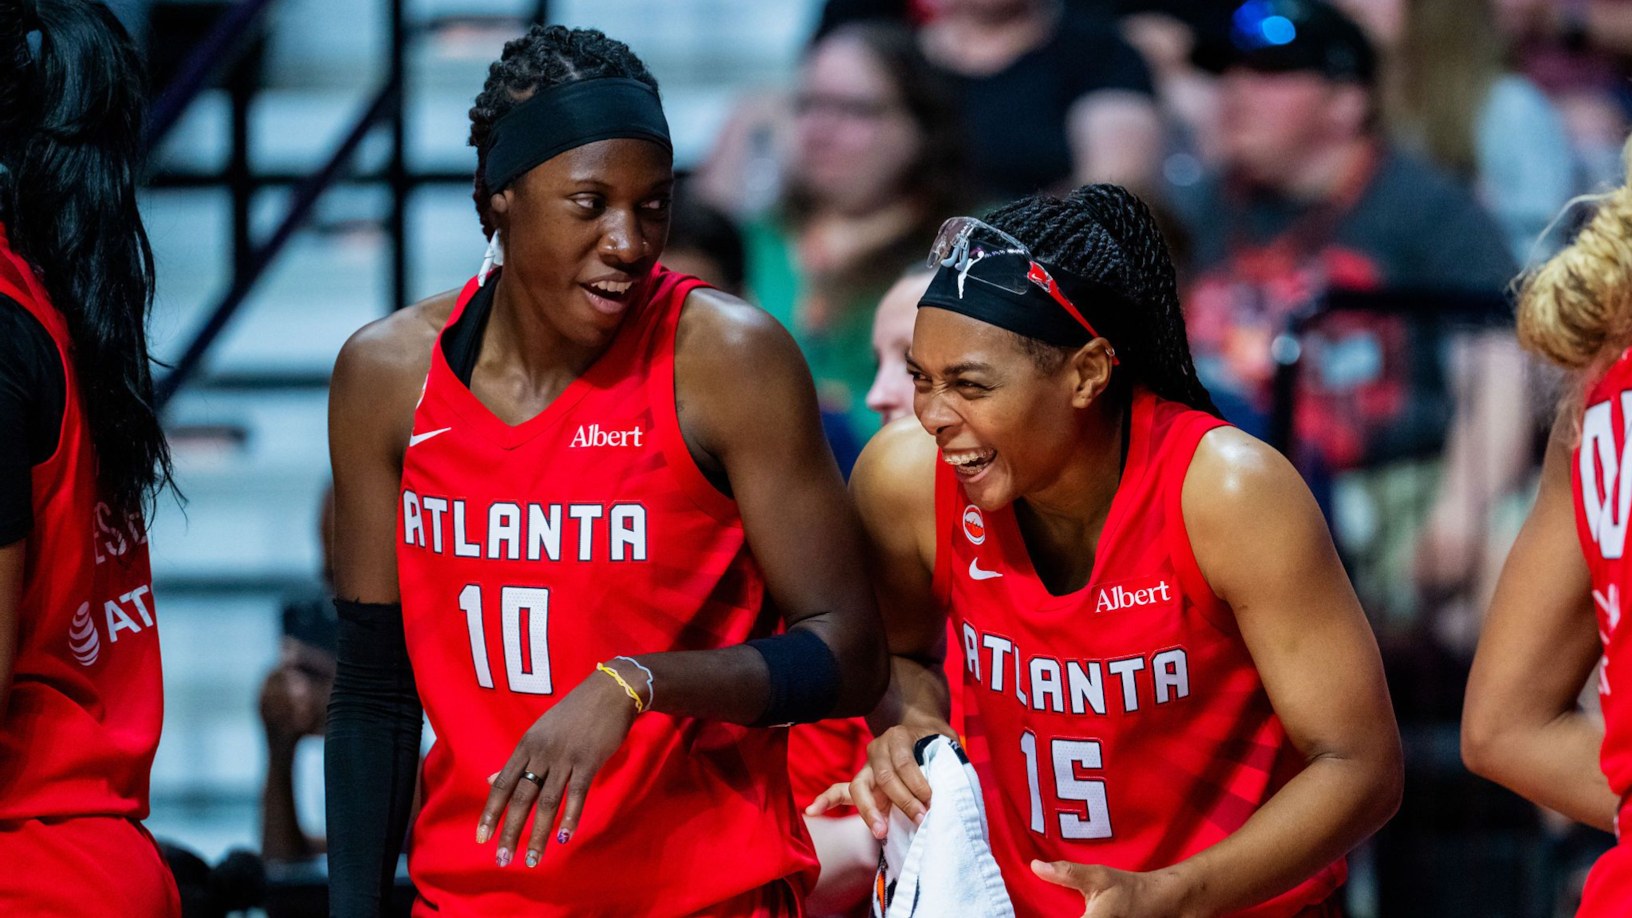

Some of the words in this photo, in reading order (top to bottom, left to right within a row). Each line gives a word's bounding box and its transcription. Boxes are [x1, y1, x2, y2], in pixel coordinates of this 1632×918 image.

[568, 424, 643, 448] Albert
[402, 488, 647, 562] ATLANTA
[1094, 580, 1171, 613] Albert
[458, 584, 553, 695] 10
[962, 620, 1191, 715] ATLANTA
[1019, 729, 1114, 840] 15
